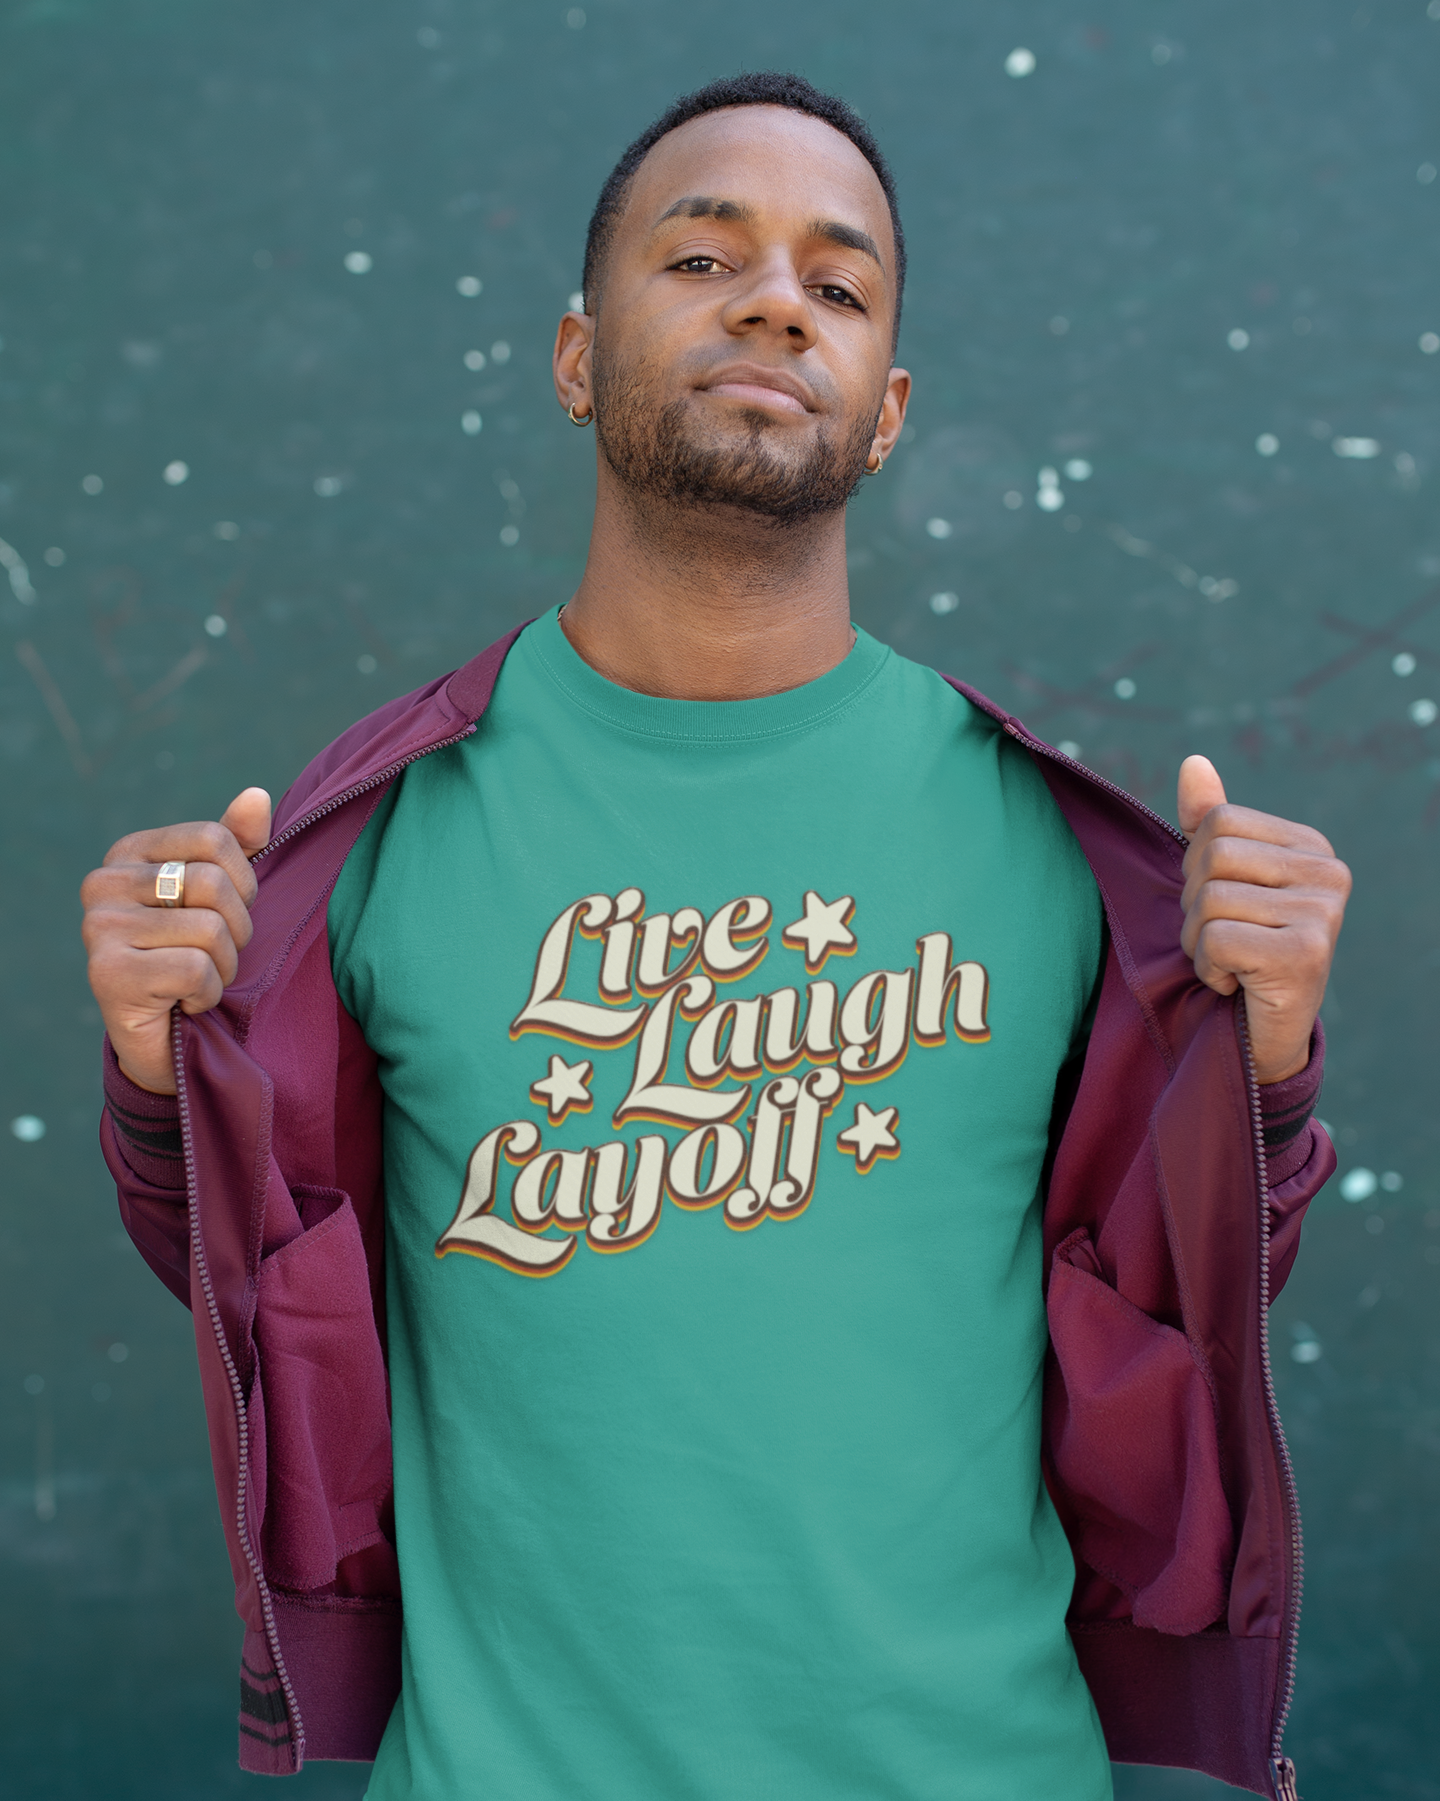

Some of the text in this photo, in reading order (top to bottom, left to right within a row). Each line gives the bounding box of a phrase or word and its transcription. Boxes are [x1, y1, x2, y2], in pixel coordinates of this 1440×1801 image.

[509, 887, 772, 1049] Live
[612, 931, 991, 1129] Laugh
[434, 1066, 844, 1278] Layoff
